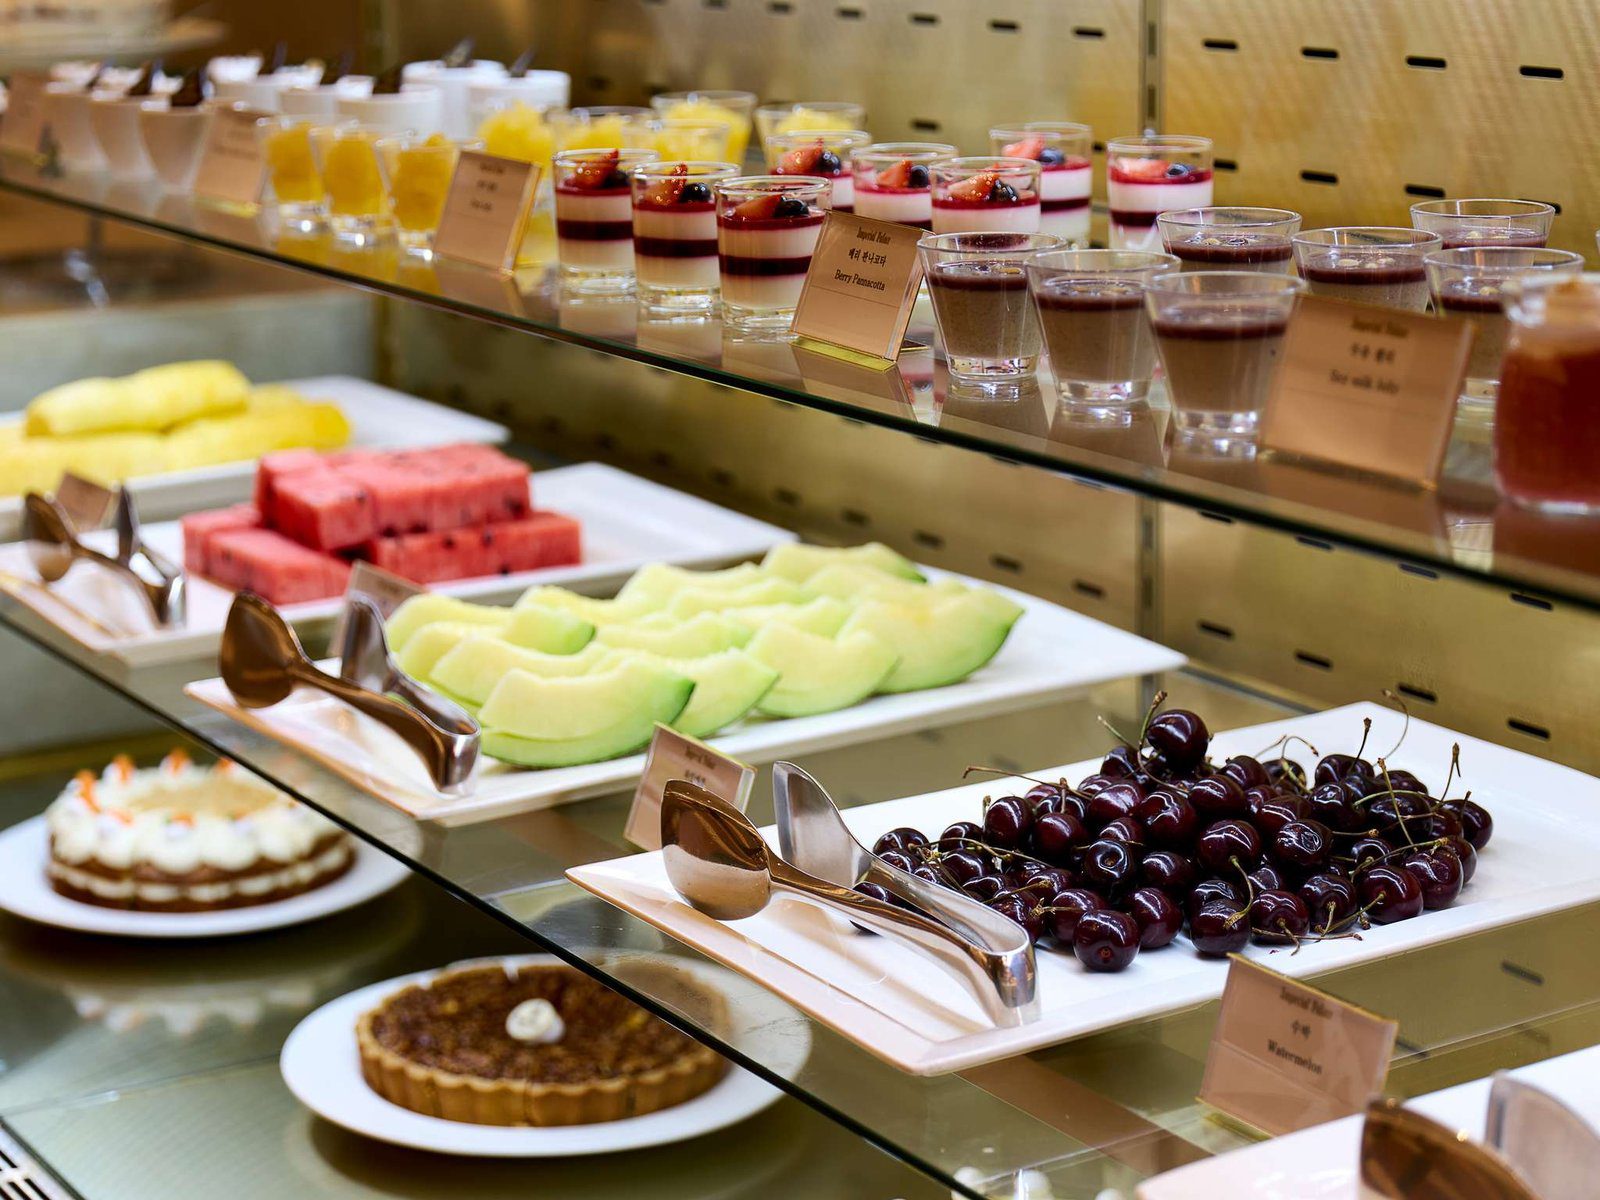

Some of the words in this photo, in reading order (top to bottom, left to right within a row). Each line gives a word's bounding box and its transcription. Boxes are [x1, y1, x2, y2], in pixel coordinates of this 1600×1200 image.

[834, 269, 852, 284] Berry
[852, 273, 886, 291] Pannacotta
[1267, 1038, 1322, 1075] Watermelon
